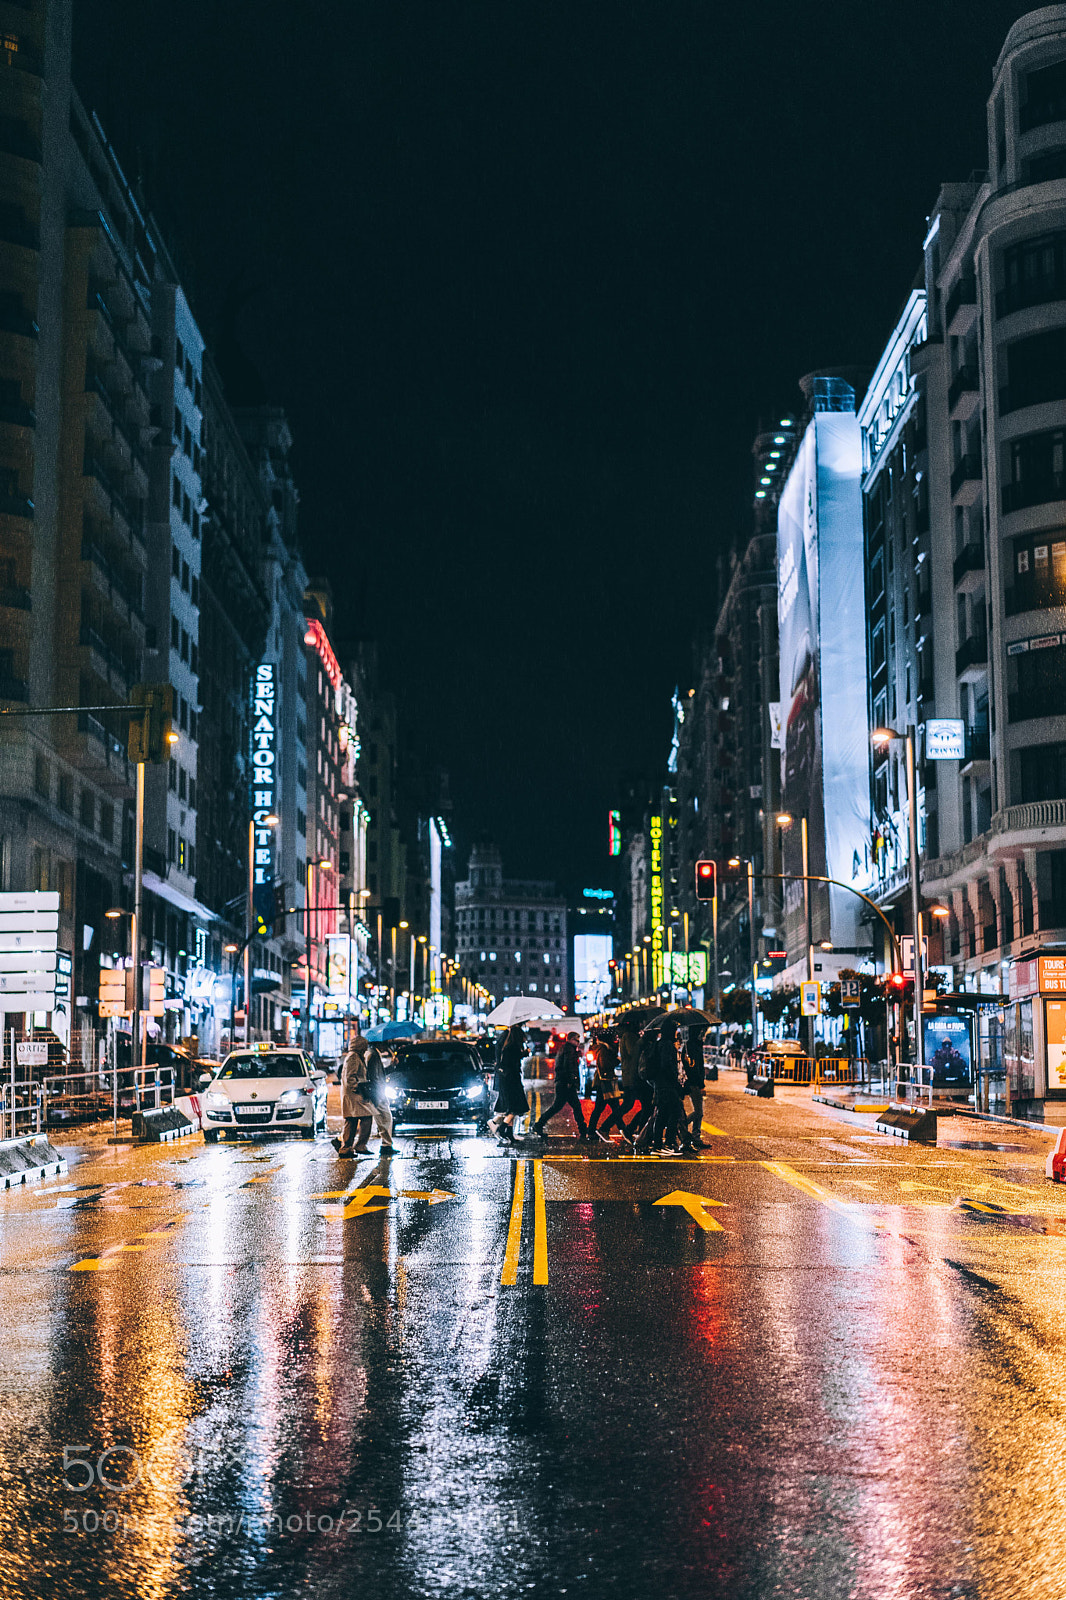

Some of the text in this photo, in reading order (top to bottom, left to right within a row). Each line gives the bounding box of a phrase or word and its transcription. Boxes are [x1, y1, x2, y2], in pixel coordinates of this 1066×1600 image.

[253, 664, 275, 885] SENATOR HOTEL
[650, 816, 663, 970] HOTEL EMPERADO
[1043, 959, 1065, 970] TOURS
[1044, 979, 1059, 990] BUS
